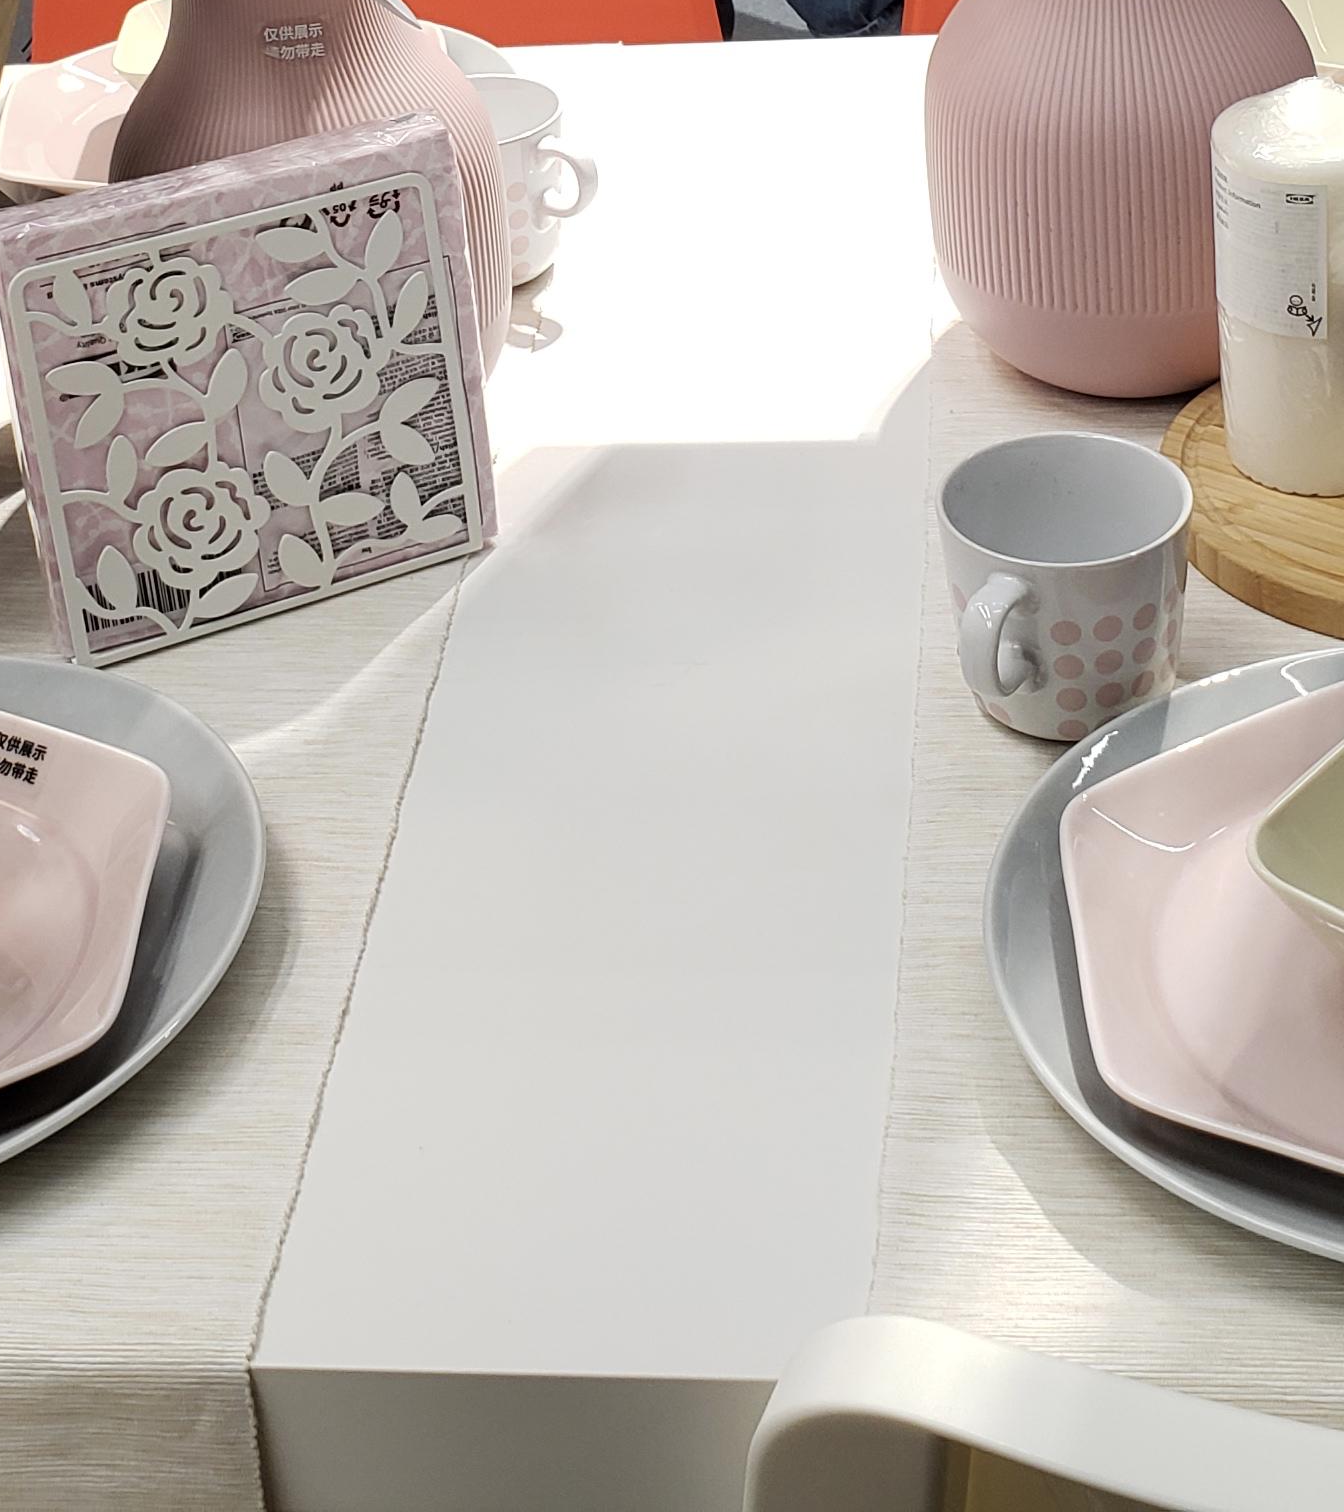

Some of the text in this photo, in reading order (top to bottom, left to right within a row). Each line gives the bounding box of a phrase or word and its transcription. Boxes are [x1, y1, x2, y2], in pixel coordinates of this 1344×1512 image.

[263, 23, 323, 42] 仅供展示
[333, 203, 346, 214] 05
[89, 273, 124, 287] ystems
[77, 335, 107, 349] Quality
